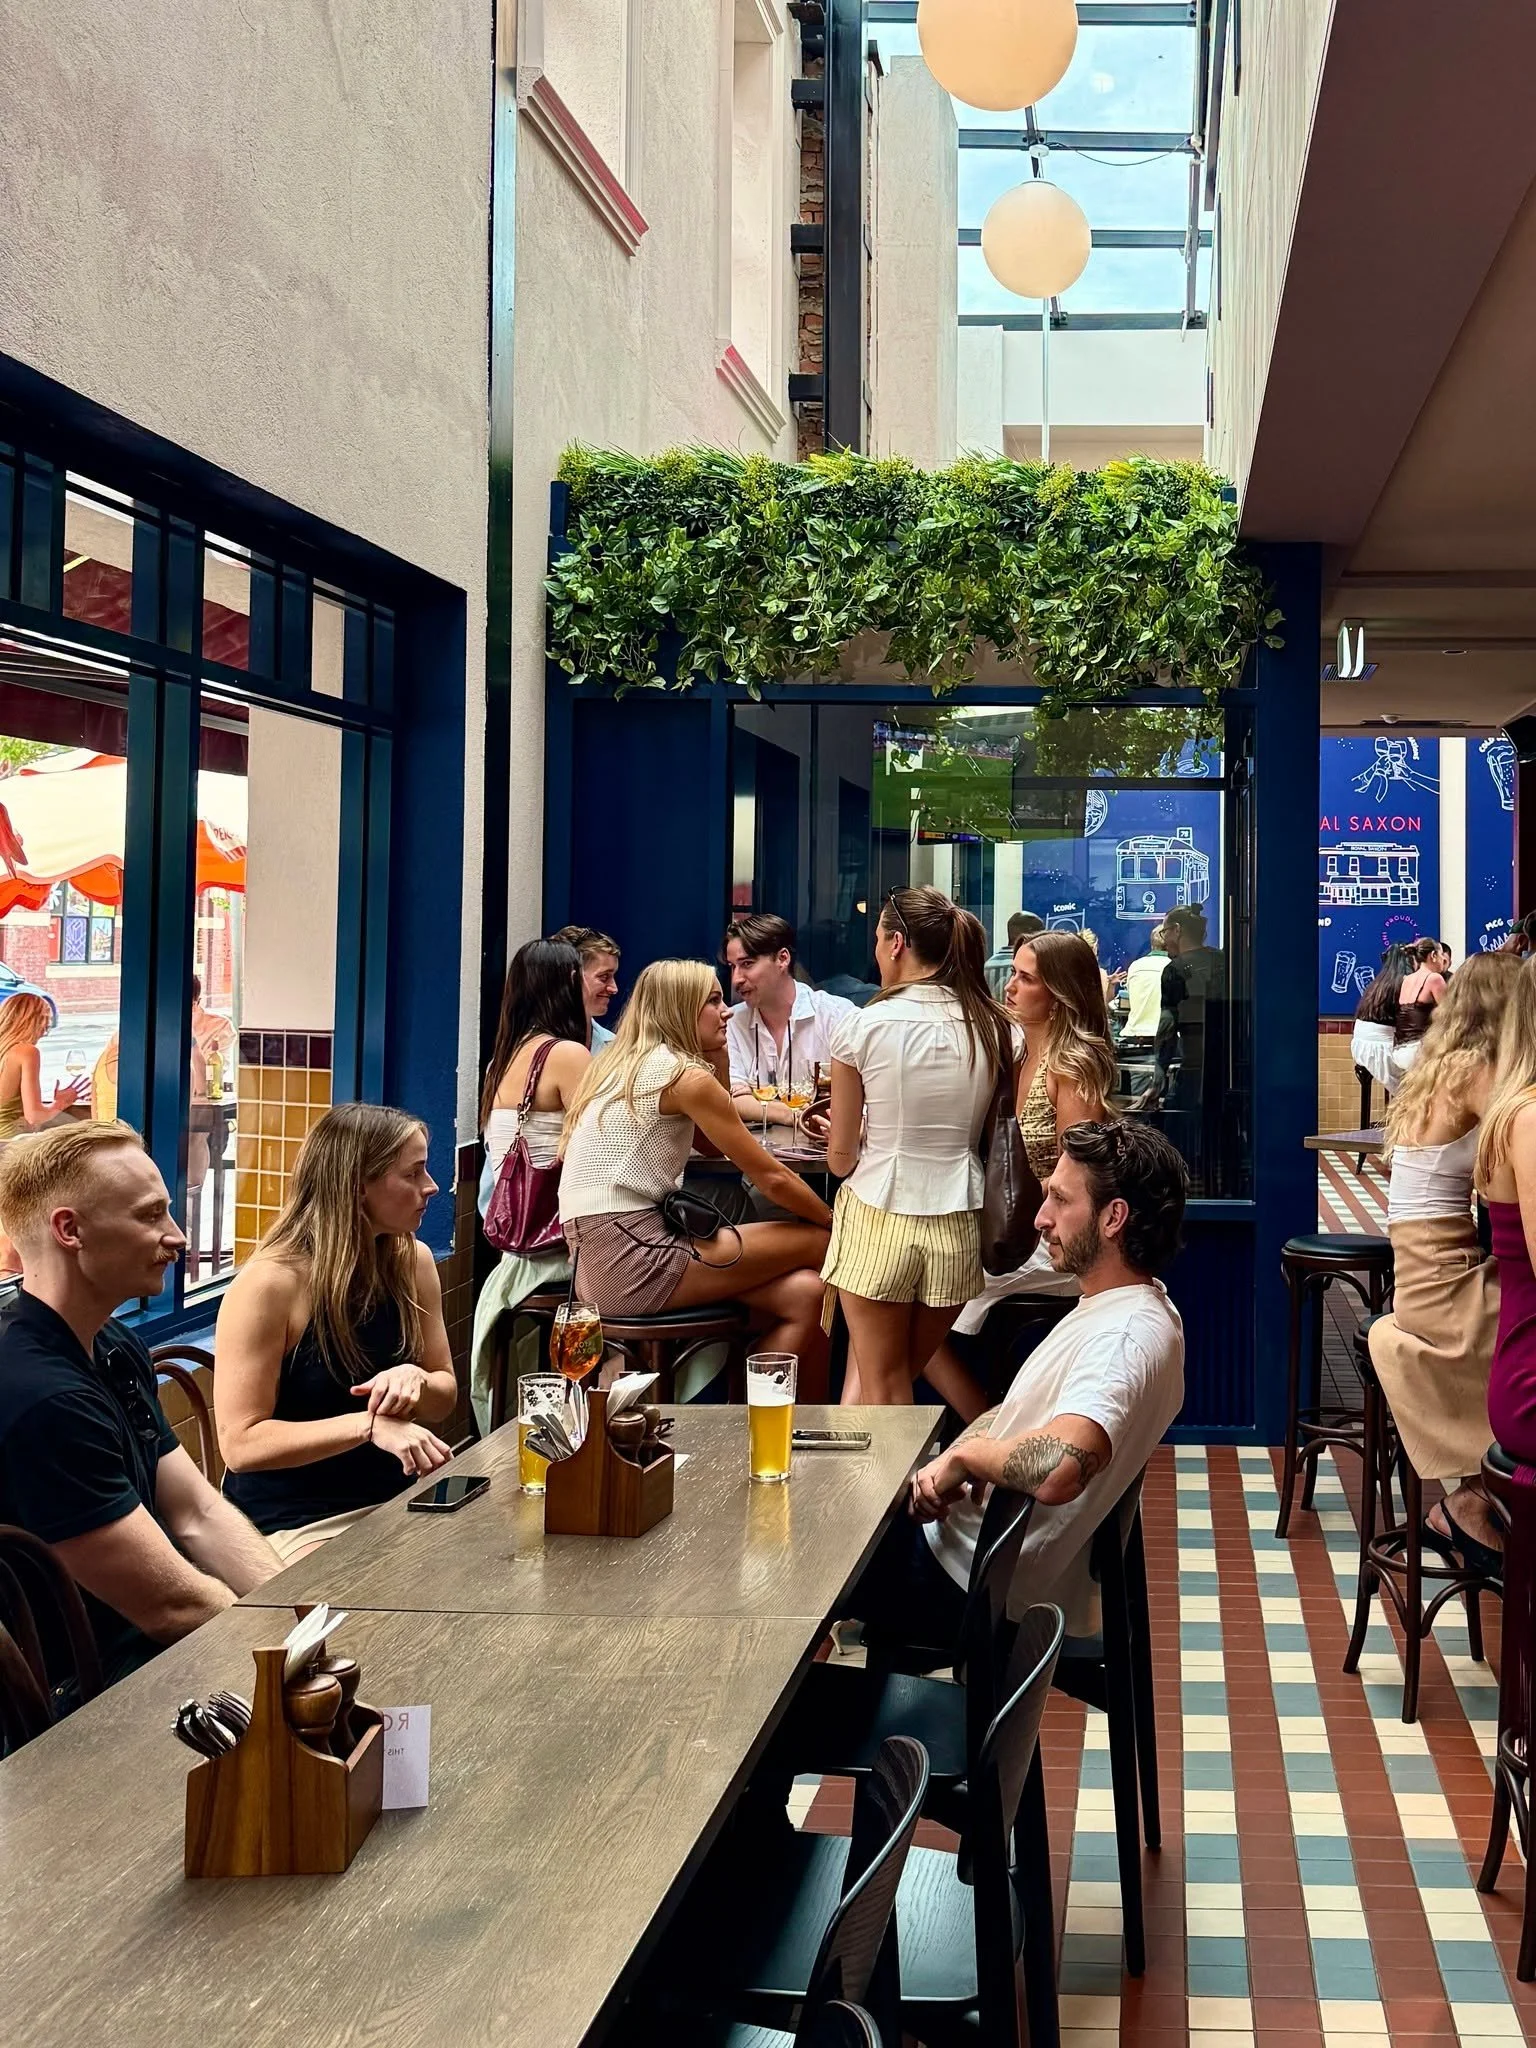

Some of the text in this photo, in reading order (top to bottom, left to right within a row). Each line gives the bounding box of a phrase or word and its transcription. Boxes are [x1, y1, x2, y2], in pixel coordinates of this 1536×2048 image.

[1350, 816, 1421, 831] SAXON
[1143, 904, 1155, 913] 78
[1385, 915, 1418, 927] PROUDLY
[1485, 918, 1504, 931] MCG
